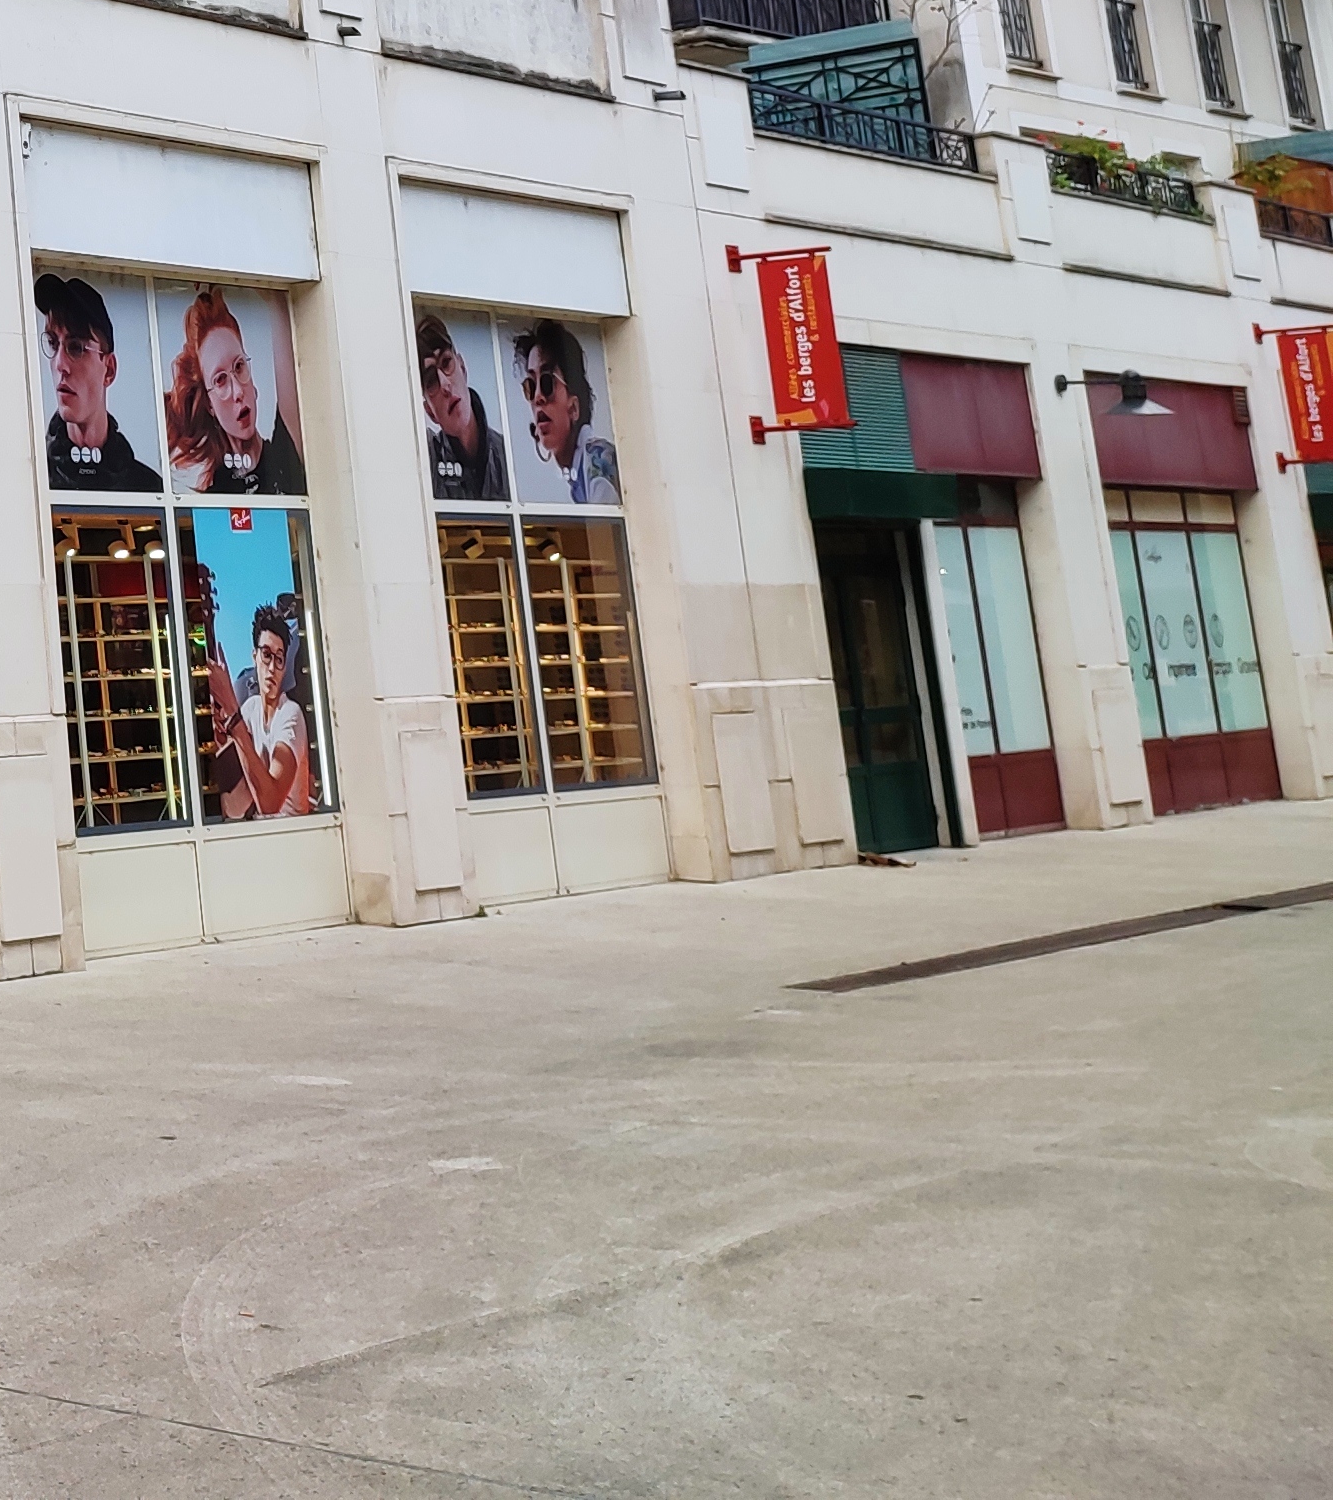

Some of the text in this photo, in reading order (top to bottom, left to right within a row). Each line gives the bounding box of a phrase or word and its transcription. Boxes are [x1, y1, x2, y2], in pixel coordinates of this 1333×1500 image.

[784, 265, 816, 403] les berges d'Alfort
